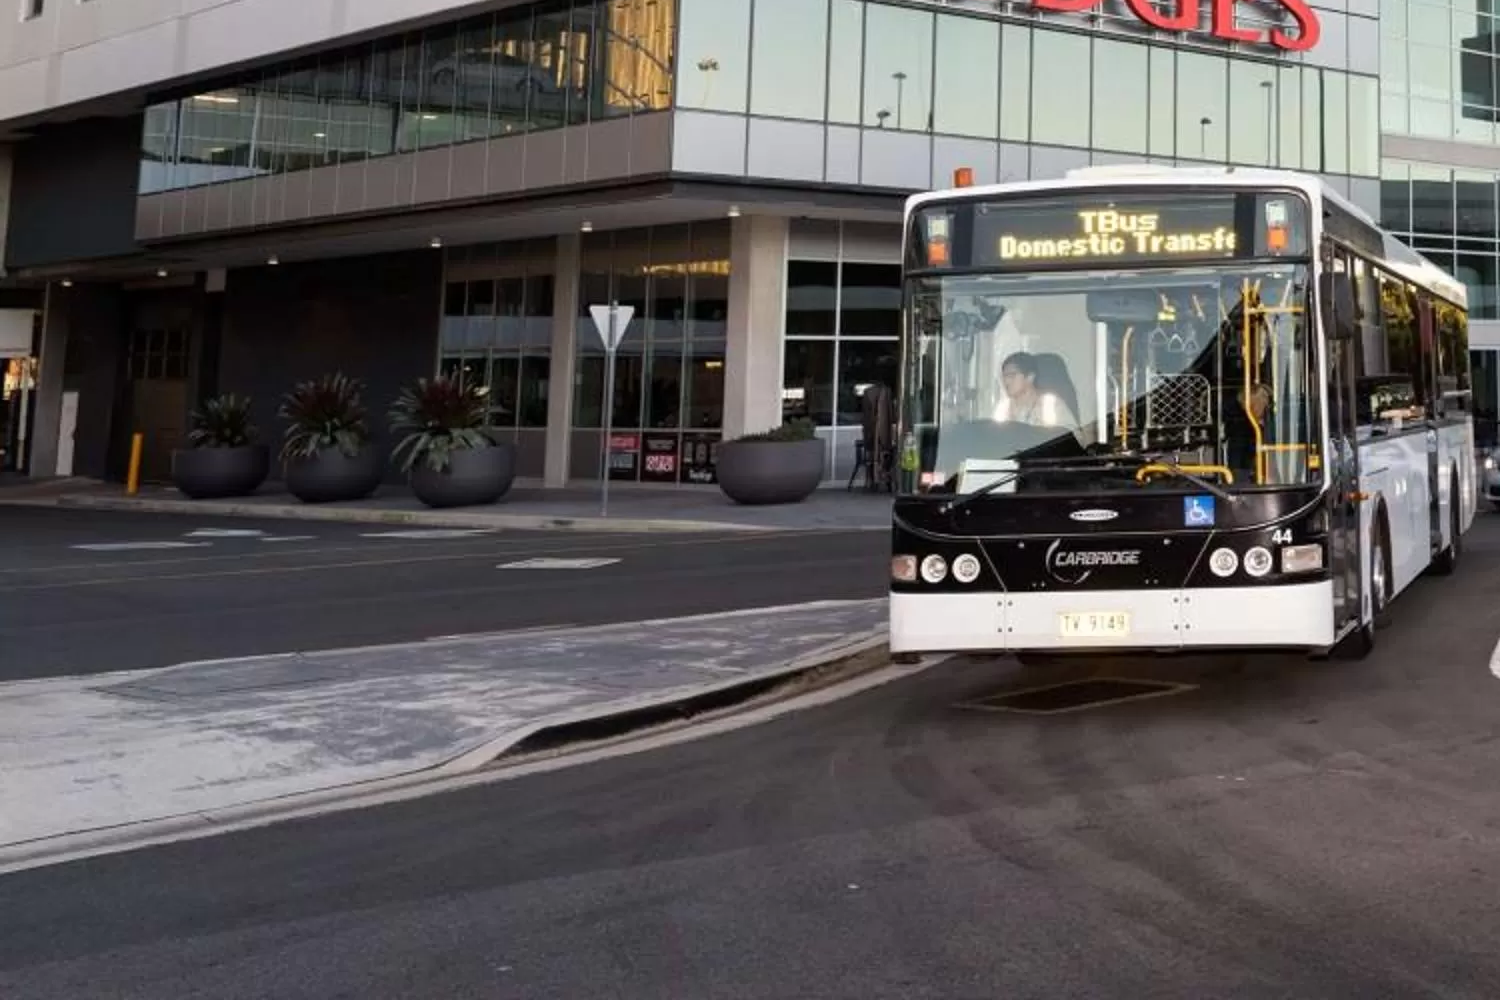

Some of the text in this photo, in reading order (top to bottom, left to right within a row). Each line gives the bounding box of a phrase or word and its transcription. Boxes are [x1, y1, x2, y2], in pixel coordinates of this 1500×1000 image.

[1078, 209, 1159, 233] TBus
[999, 233, 1126, 259] Domestic
[1271, 528, 1293, 545] 44
[1055, 550, 1142, 567] CARBRIDGE
